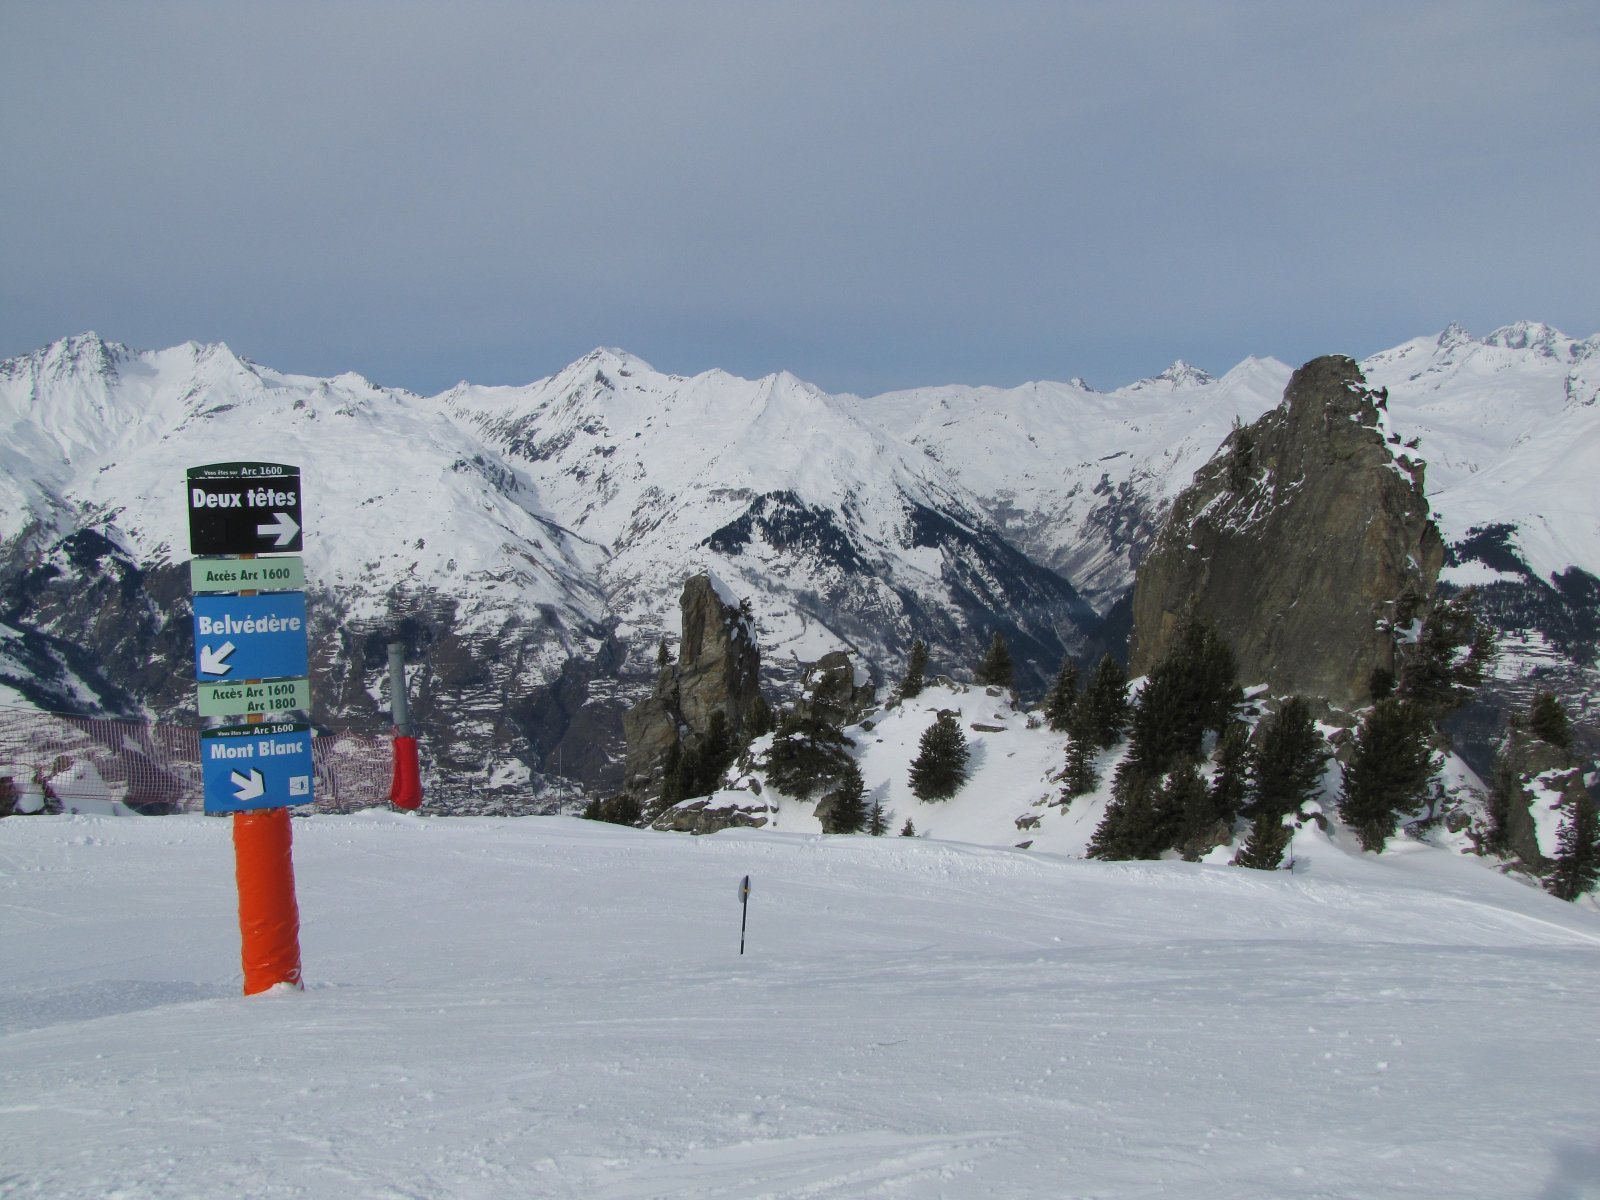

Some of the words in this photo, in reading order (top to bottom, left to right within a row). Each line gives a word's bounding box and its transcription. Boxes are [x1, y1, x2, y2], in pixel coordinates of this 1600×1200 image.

[241, 467, 257, 475] Arc
[260, 466, 283, 475] 1600
[192, 488, 242, 508] Deux
[247, 487, 297, 508] têtes
[206, 570, 237, 582] Accès
[240, 569, 258, 581] Arc
[262, 568, 290, 580] 1600
[199, 613, 301, 635] Belvédère
[212, 688, 242, 700] Accès
[246, 686, 264, 698] Arc
[267, 683, 295, 696] 1600
[247, 700, 265, 712] Arc
[269, 697, 296, 710] 1800
[253, 726, 268, 735] Arc
[271, 723, 294, 734] 1600
[211, 743, 253, 759] Mont
[259, 739, 303, 757] Blanc
